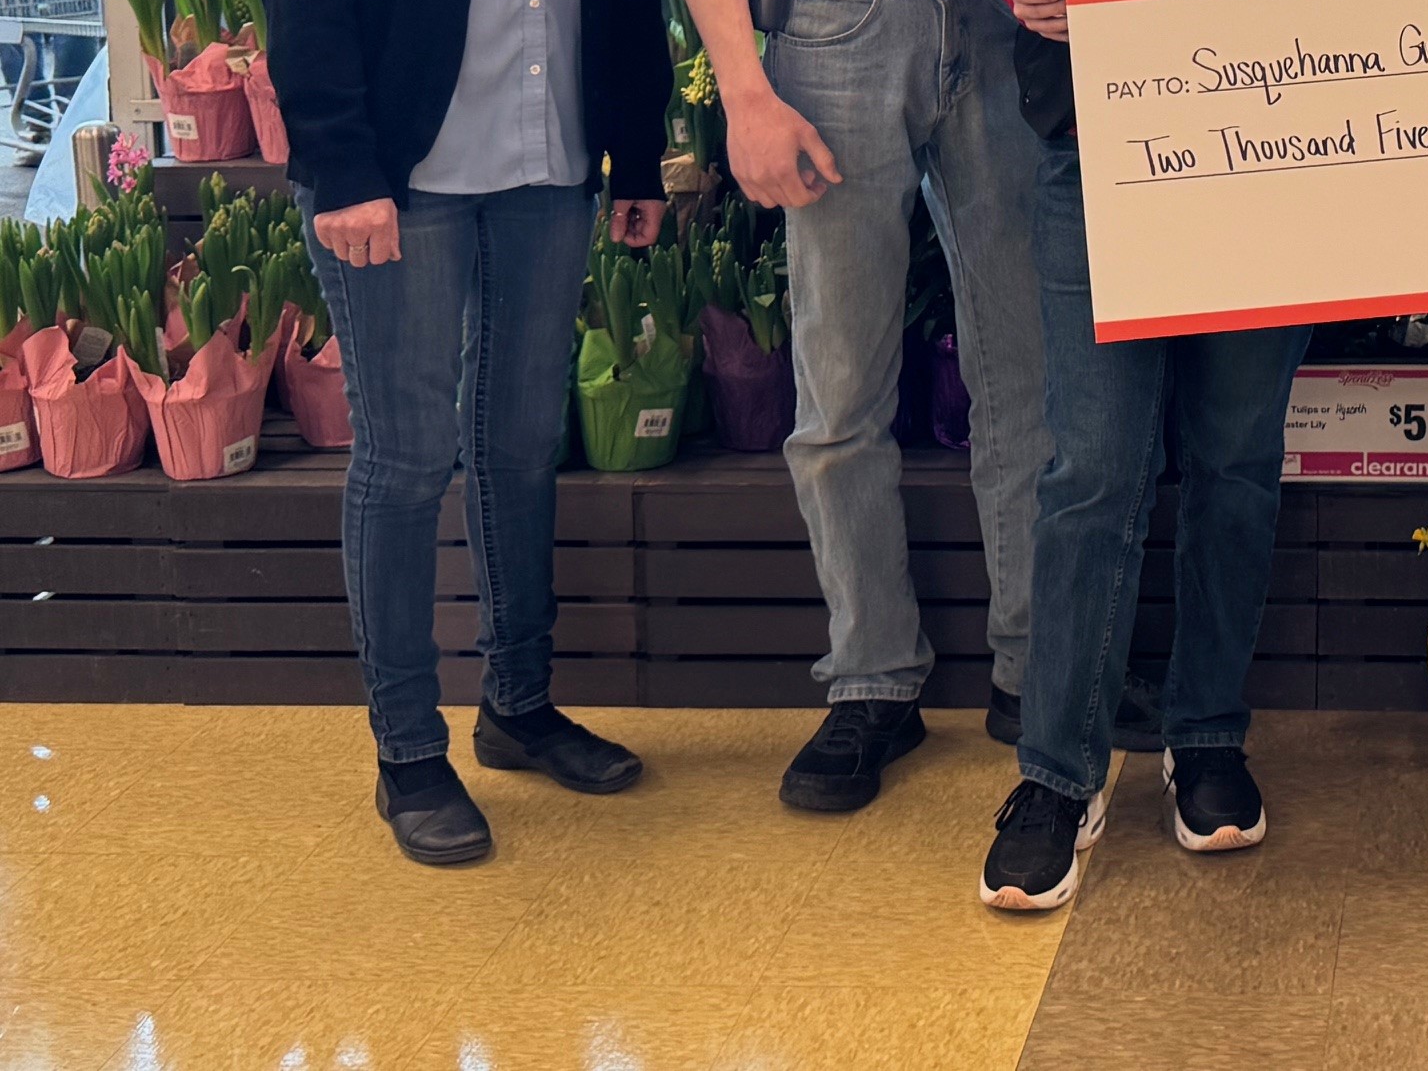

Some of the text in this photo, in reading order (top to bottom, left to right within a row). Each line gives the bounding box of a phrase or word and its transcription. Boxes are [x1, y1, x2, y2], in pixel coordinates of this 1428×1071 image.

[1106, 79, 1147, 100] PAY
[1152, 77, 1190, 96] TO:
[1192, 37, 1386, 106] Susquehanna
[1126, 135, 1196, 177] Two
[1208, 119, 1356, 171] Thousand
[1291, 405, 1318, 415] Tulips
[1389, 404, 1426, 441] $5
[1310, 420, 1327, 430] Lily
